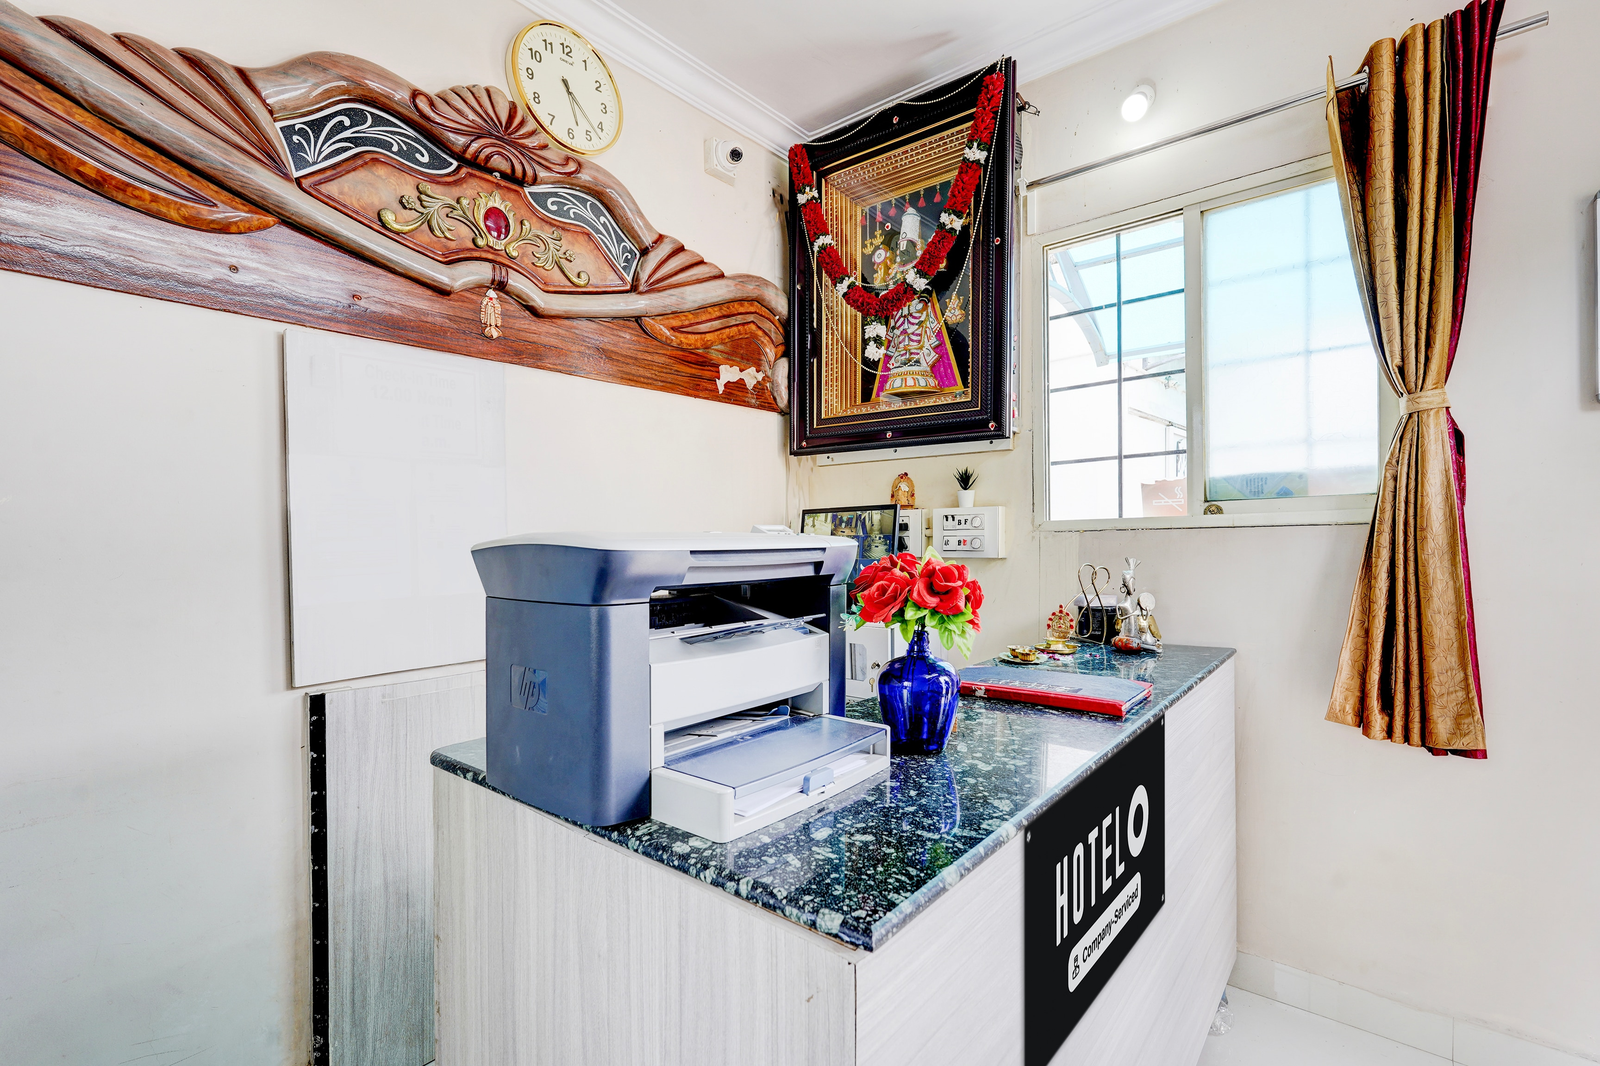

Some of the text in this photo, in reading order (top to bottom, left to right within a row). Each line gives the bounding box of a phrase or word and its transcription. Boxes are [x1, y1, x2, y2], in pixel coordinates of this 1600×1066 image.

[541, 38, 554, 54] 11
[559, 42, 573, 58] 12
[528, 47, 542, 63] 10
[582, 59, 588, 71] 1
[526, 67, 534, 80] 9
[594, 80, 602, 93] 2
[532, 91, 541, 104] 8
[600, 102, 608, 114] 3
[547, 112, 556, 126] 7
[567, 127, 575, 140] 6
[597, 121, 604, 133] 4
[585, 129, 592, 142] 5
[427, 373, 456, 390] Time
[1055, 805, 1125, 947] HOTEL
[1082, 882, 1139, 964] Company-Serviced
